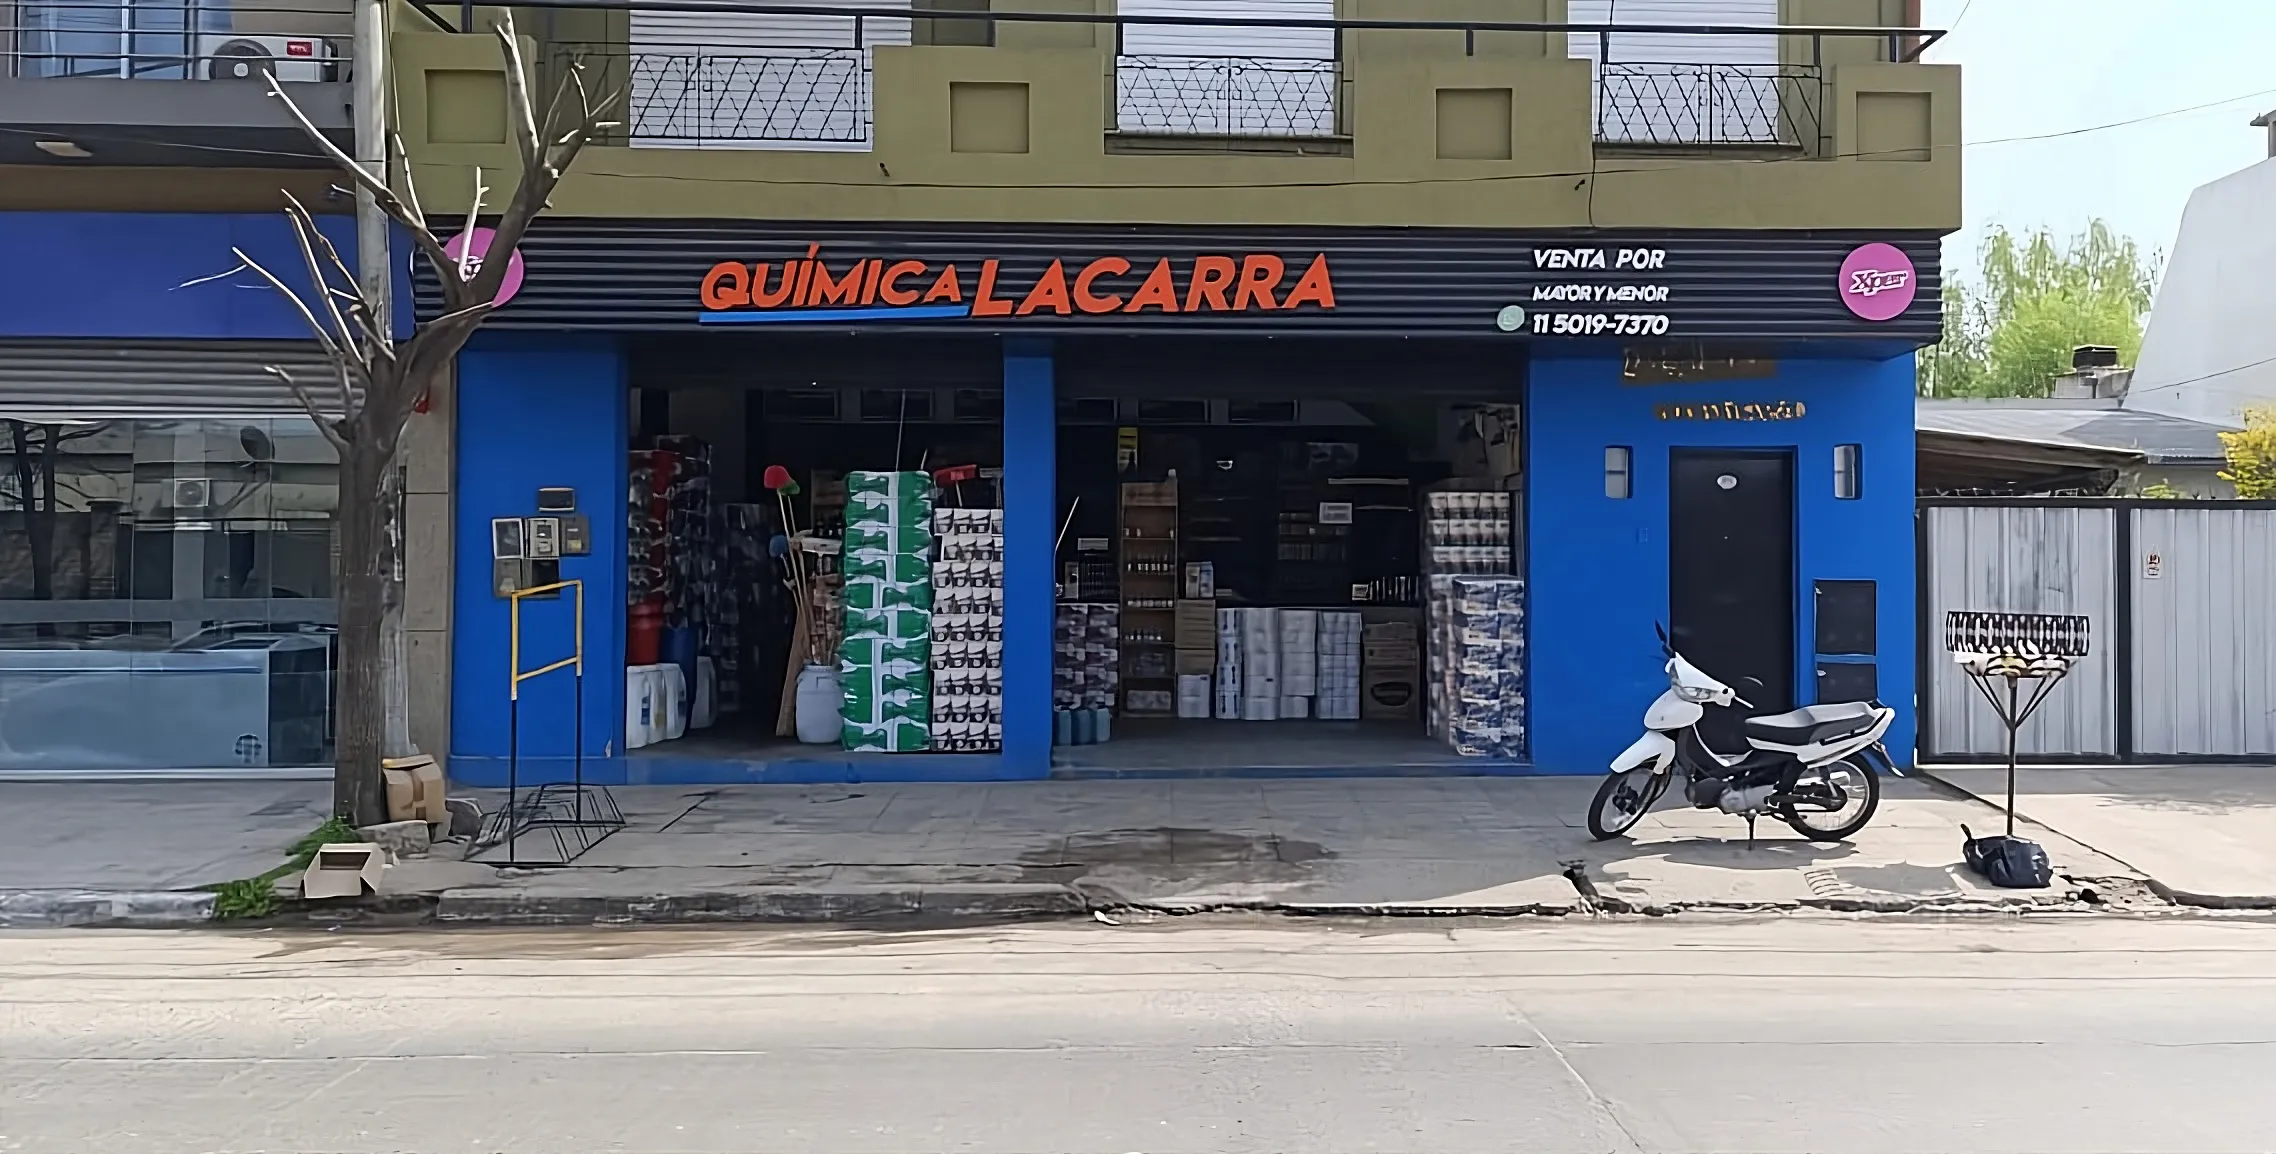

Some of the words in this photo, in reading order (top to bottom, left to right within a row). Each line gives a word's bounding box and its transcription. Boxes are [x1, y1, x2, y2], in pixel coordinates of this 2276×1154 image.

[1533, 248, 1606, 269] VENTA
[1615, 248, 1666, 270] POR
[700, 243, 961, 310] QUÍMICA
[973, 254, 1335, 316] LACARRA
[1532, 284, 1592, 302] MAYOR
[1593, 285, 1607, 301] Y
[1606, 284, 1669, 302] MENOR
[1533, 313, 1550, 334] 11
[1552, 313, 1670, 335] 5019-7370
